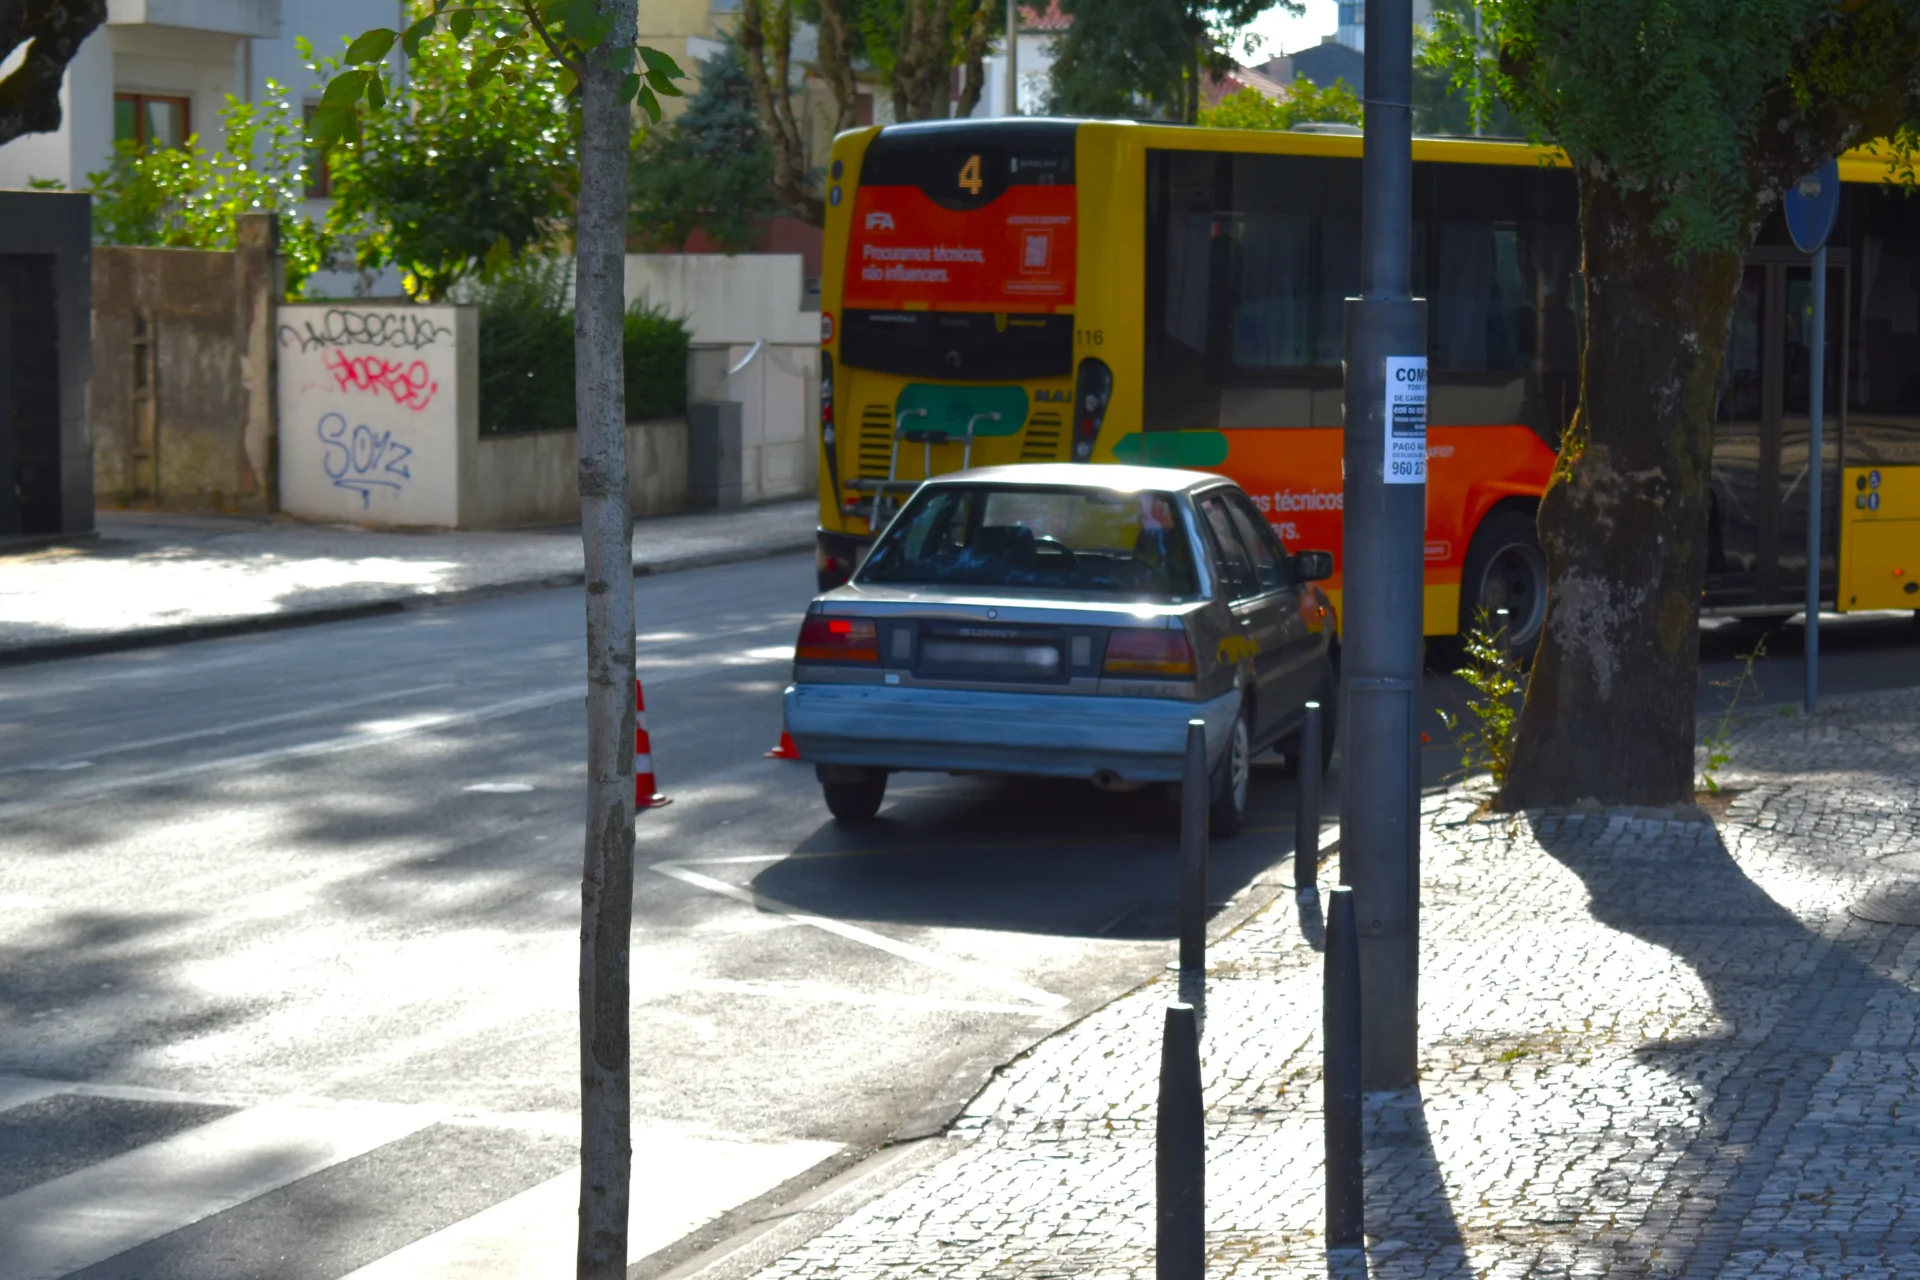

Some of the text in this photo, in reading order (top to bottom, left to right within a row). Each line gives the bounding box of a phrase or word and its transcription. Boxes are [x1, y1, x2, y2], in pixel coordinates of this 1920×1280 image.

[957, 154, 983, 194] 4
[862, 243, 931, 261] Procuramos
[1076, 330, 1104, 346] 116
[1393, 443, 1415, 451] PAGO
[1392, 461, 1412, 475] 960
[958, 628, 1019, 639] SUNNY
